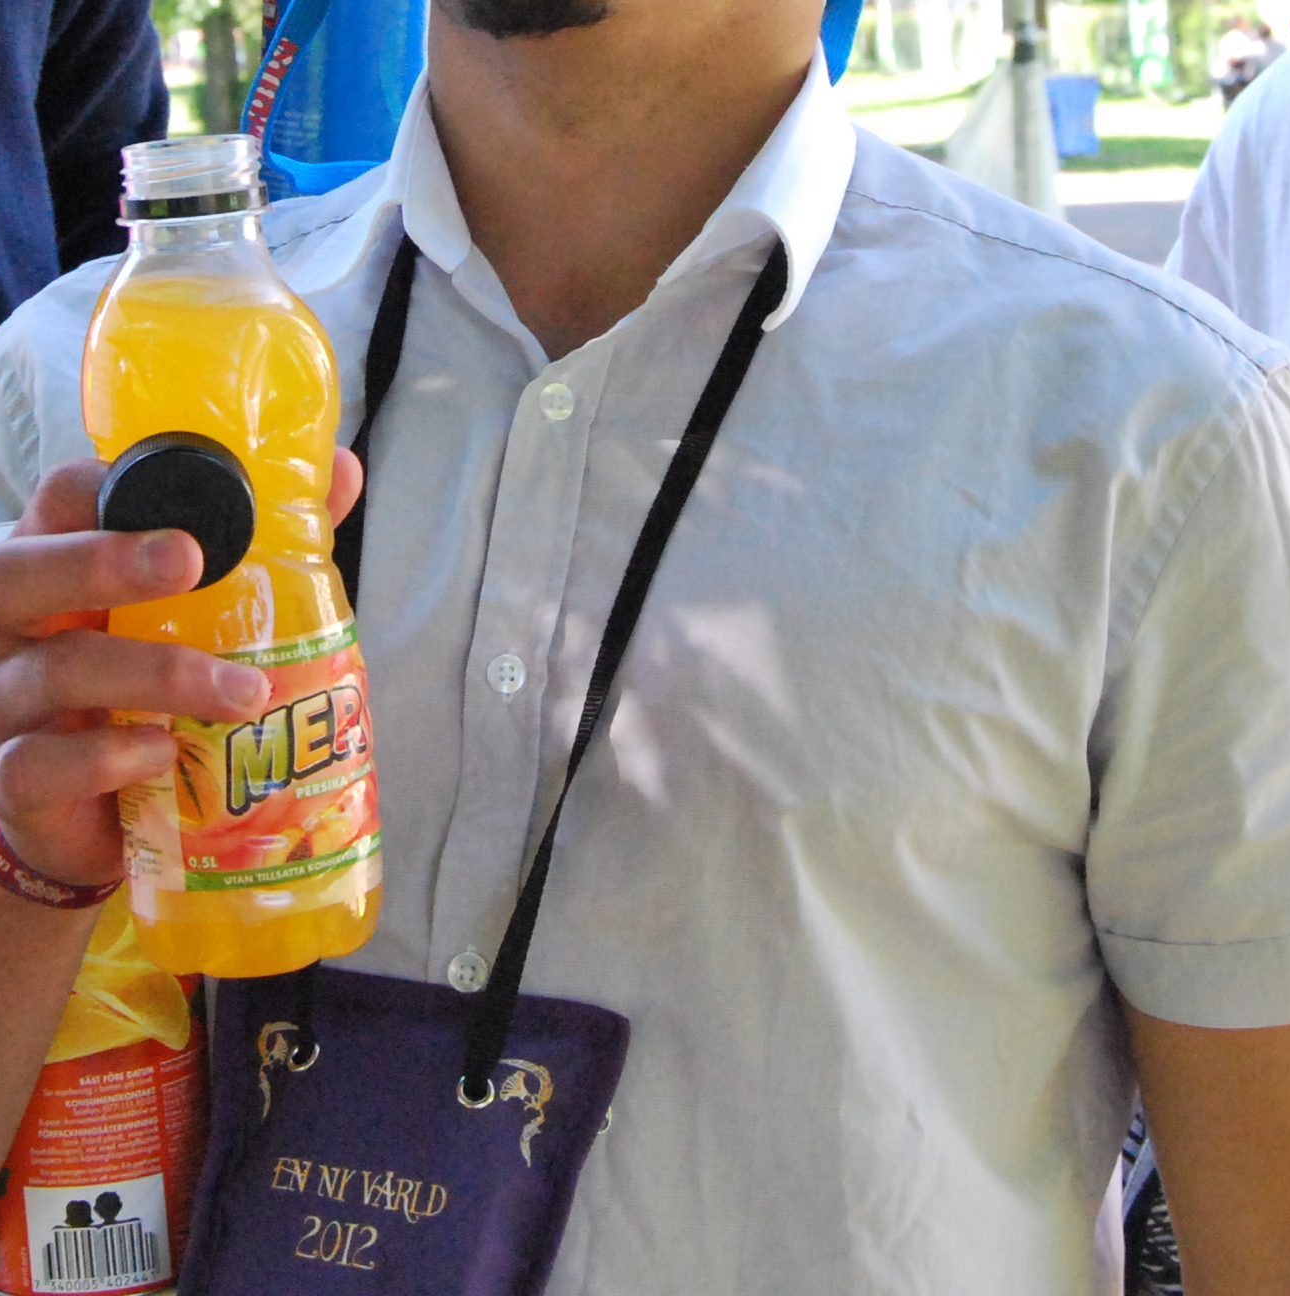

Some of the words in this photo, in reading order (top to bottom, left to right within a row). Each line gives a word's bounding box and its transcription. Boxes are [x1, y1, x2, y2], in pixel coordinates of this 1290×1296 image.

[226, 685, 367, 816] MER
[295, 775, 348, 799] PERSIKA
[188, 856, 218, 869] 0.5L
[224, 874, 254, 885] UTAN
[256, 866, 305, 882] TILLSATTA
[271, 1157, 312, 1193] EN
[317, 1164, 356, 1202] NY
[295, 1215, 378, 1270] 2012
